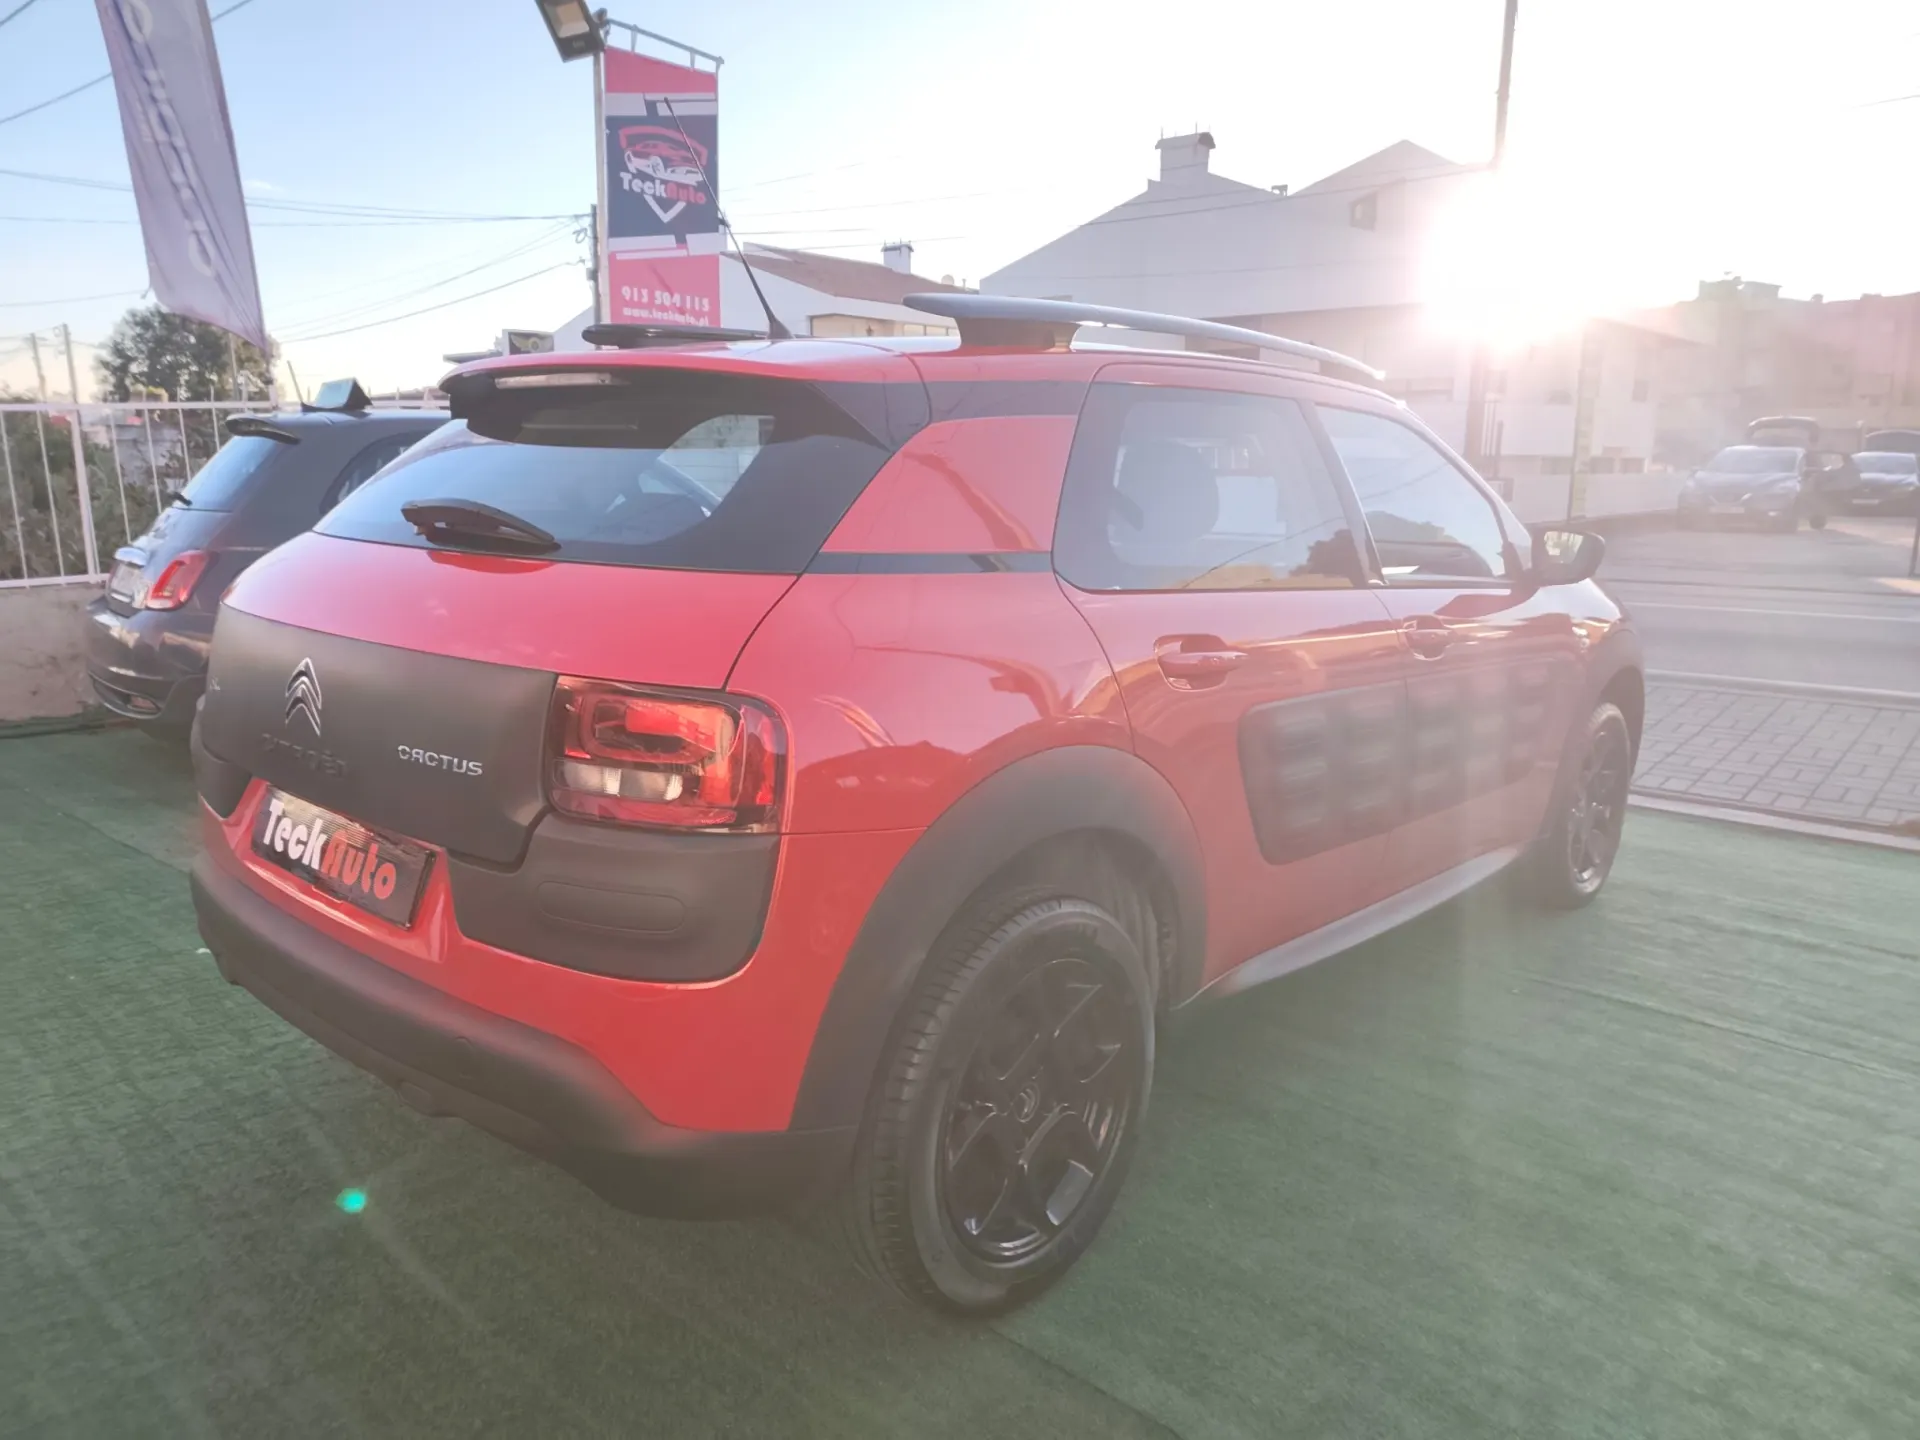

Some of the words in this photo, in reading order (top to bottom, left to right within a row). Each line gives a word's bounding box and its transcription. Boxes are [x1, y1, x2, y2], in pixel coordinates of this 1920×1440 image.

[654, 290, 682, 308] 504
[685, 295, 710, 312] 115
[397, 744, 483, 777] CACTUS
[263, 798, 397, 900] TeckAuto
